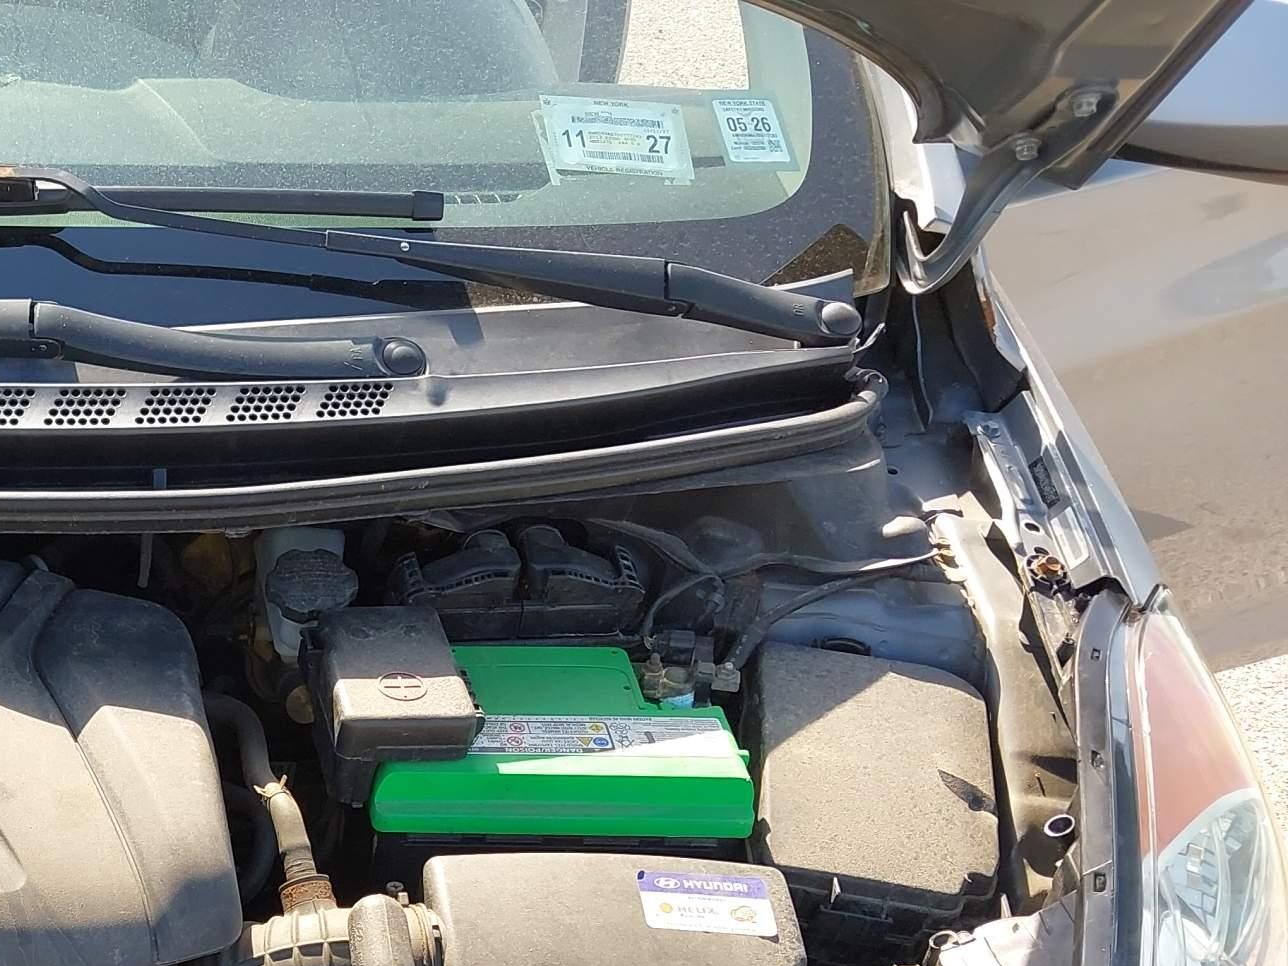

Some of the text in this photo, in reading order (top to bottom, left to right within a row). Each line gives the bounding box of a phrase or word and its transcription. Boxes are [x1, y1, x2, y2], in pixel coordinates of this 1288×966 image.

[726, 117, 772, 132] 05 26
[561, 129, 586, 148] 11
[646, 134, 671, 154] 27
[615, 167, 664, 176] REGISTRATION
[682, 879, 748, 893] HYUNDAI
